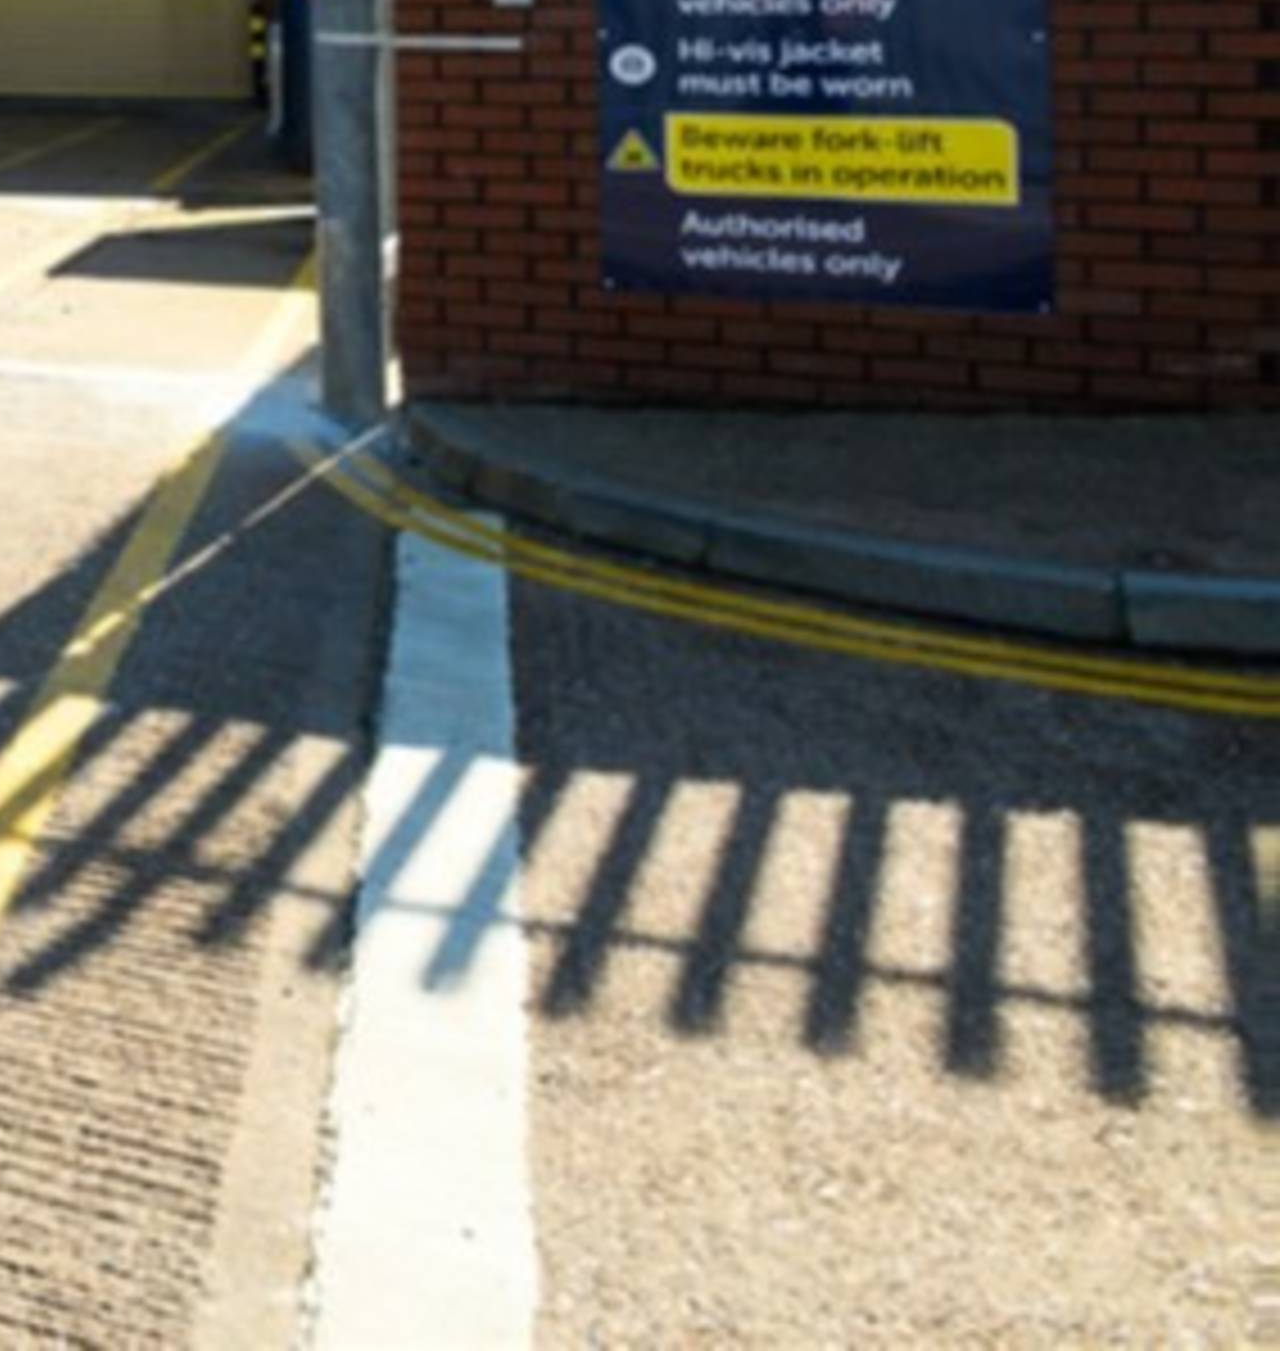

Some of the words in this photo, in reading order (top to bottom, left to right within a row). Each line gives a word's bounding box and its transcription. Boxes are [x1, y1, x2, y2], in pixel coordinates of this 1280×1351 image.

[677, 37, 771, 63] Hi-vis
[779, 39, 883, 69] jacket
[677, 73, 762, 94] must
[769, 72, 813, 95] be
[820, 78, 912, 97] worn
[680, 124, 801, 149] Beware
[680, 159, 782, 183] trucks
[790, 162, 822, 183] in
[832, 164, 1005, 191] operation
[680, 211, 865, 242] Authorised
[681, 246, 815, 274] vehicles
[824, 251, 903, 284] only
